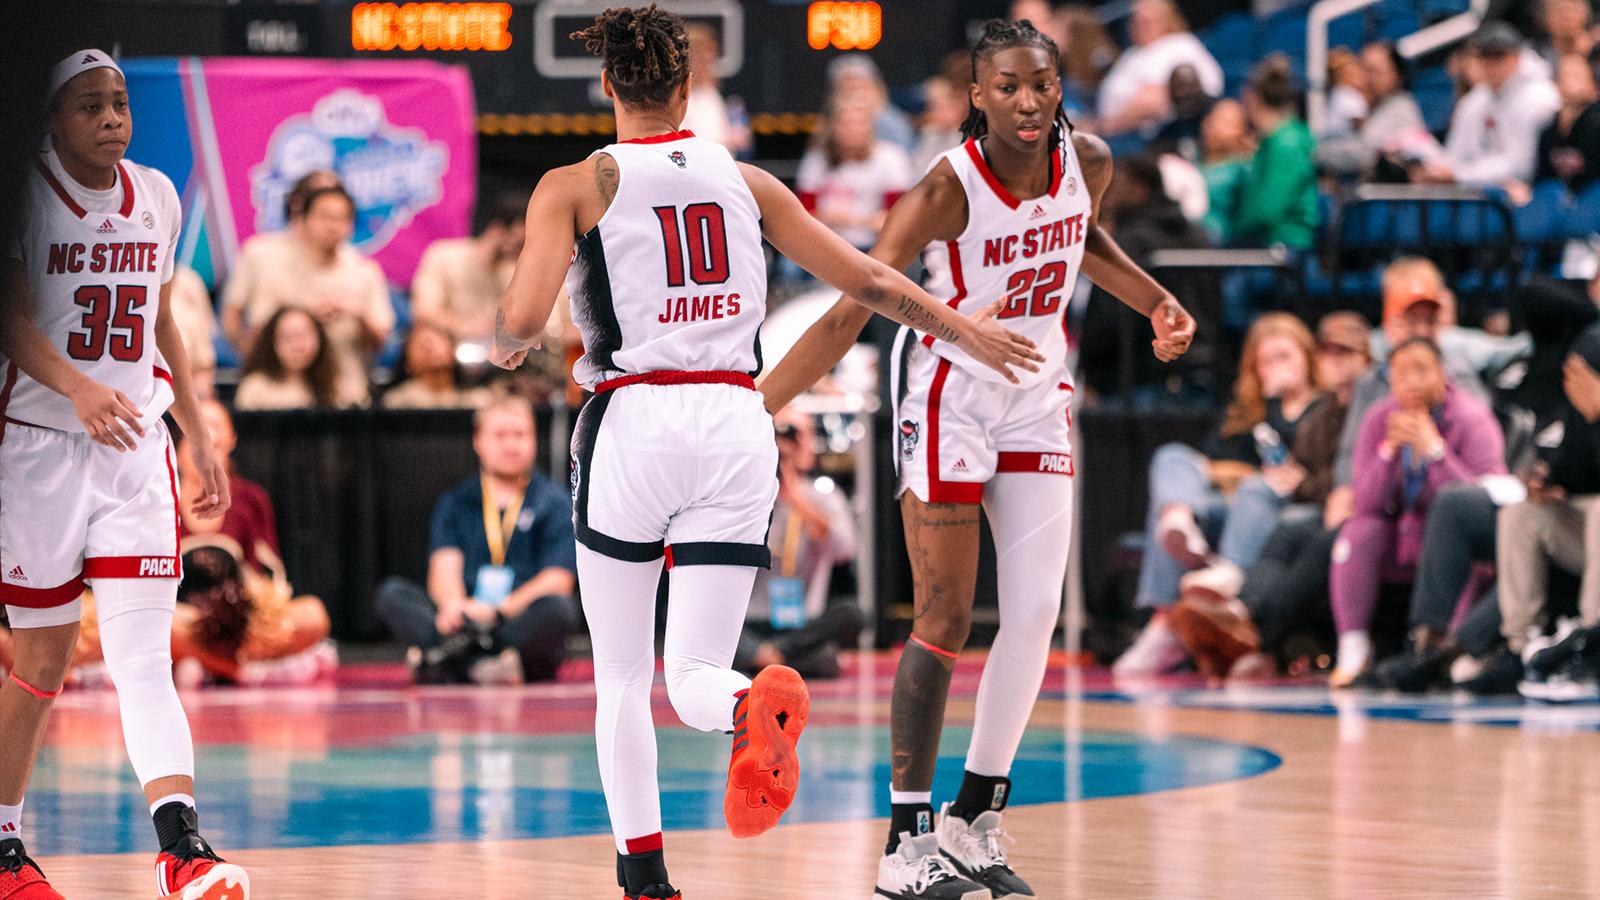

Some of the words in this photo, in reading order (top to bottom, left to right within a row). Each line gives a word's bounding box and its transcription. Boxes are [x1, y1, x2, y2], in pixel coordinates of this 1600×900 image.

[400, 2, 513, 51] STATE
[807, 1, 882, 50] FSU
[46, 243, 86, 274] NC
[89, 242, 159, 274] STATE
[652, 202, 730, 288] 10
[983, 235, 1019, 268] NC
[1022, 213, 1084, 259] STATE
[658, 293, 741, 324] JAMES
[996, 260, 1068, 320] 22
[66, 284, 148, 363] 35
[1039, 454, 1073, 474] PACK
[139, 558, 176, 577] PACK
